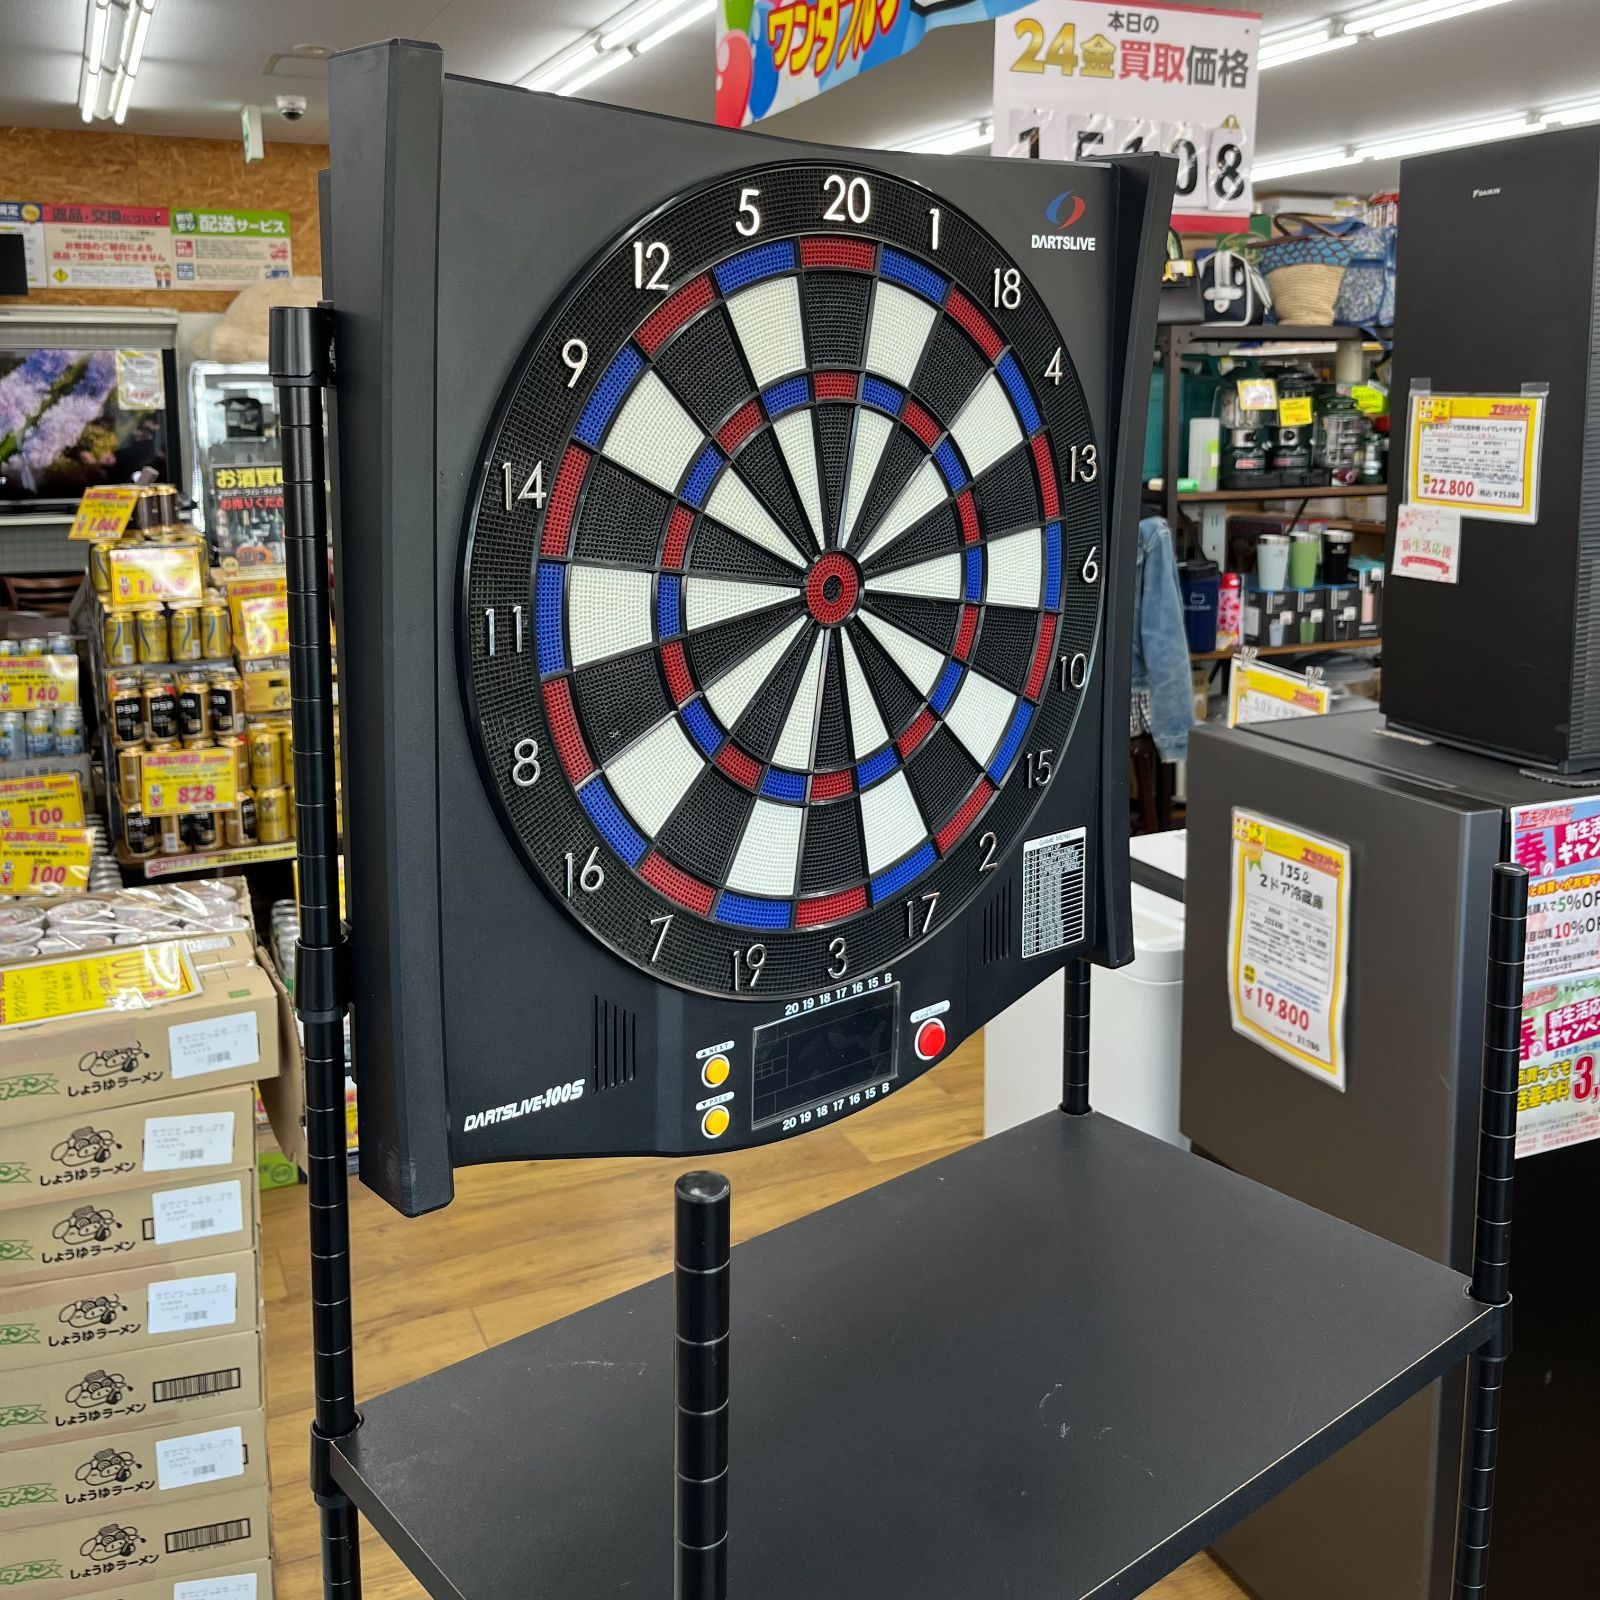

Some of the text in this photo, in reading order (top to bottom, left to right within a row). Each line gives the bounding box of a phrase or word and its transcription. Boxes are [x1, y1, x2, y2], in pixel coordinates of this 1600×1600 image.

[1108, 11, 1159, 34] 本日の
[1009, 18, 1250, 89] 24金買取価格
[735, 188, 761, 236] 5
[823, 175, 871, 223] 20
[199, 213, 286, 235] 配送サービス
[929, 208, 940, 250] 1
[1031, 235, 1096, 251] DARTSLIVE
[633, 241, 671, 291] 12
[994, 267, 1022, 310] 18
[562, 338, 588, 388] 9
[1043, 346, 1064, 386] 4
[1070, 444, 1098, 482] 13
[502, 460, 547, 511] 14
[1081, 546, 1099, 584] 6
[1402, 539, 1451, 559] 新生活応援
[485, 605, 523, 657] 11
[1060, 652, 1088, 692] 10
[26, 686, 58, 701] 140
[512, 738, 541, 787] 8
[1025, 749, 1053, 789] 15
[178, 785, 216, 804] 828
[28, 807, 64, 827] 100
[978, 831, 998, 872] 2
[30, 866, 67, 885] 100
[565, 846, 605, 899] 16
[1259, 874, 1324, 910] 2ドア冷蔵庫
[906, 892, 940, 938] 17
[650, 914, 675, 962] 7
[733, 944, 767, 991] 19
[827, 938, 849, 979] 3
[785, 972, 893, 1016] 20 19 18 17 16 15 B
[709, 1043, 729, 1054] NEXT
[67, 1071, 164, 1097] しょうゆラーメン
[709, 1094, 728, 1105] PREV
[783, 1082, 890, 1131] 20 19 18 17 16 15 B
[40, 1162, 136, 1186] しょうゆラーメン
[42, 1241, 136, 1264] しょうゆラーメン
[48, 1323, 141, 1347] しょうゆラーメン
[55, 1403, 147, 1427] しょうゆラーメン
[65, 1480, 156, 1504] しょうゆラーメン
[70, 1554, 159, 1580] しょうゆラーメン
